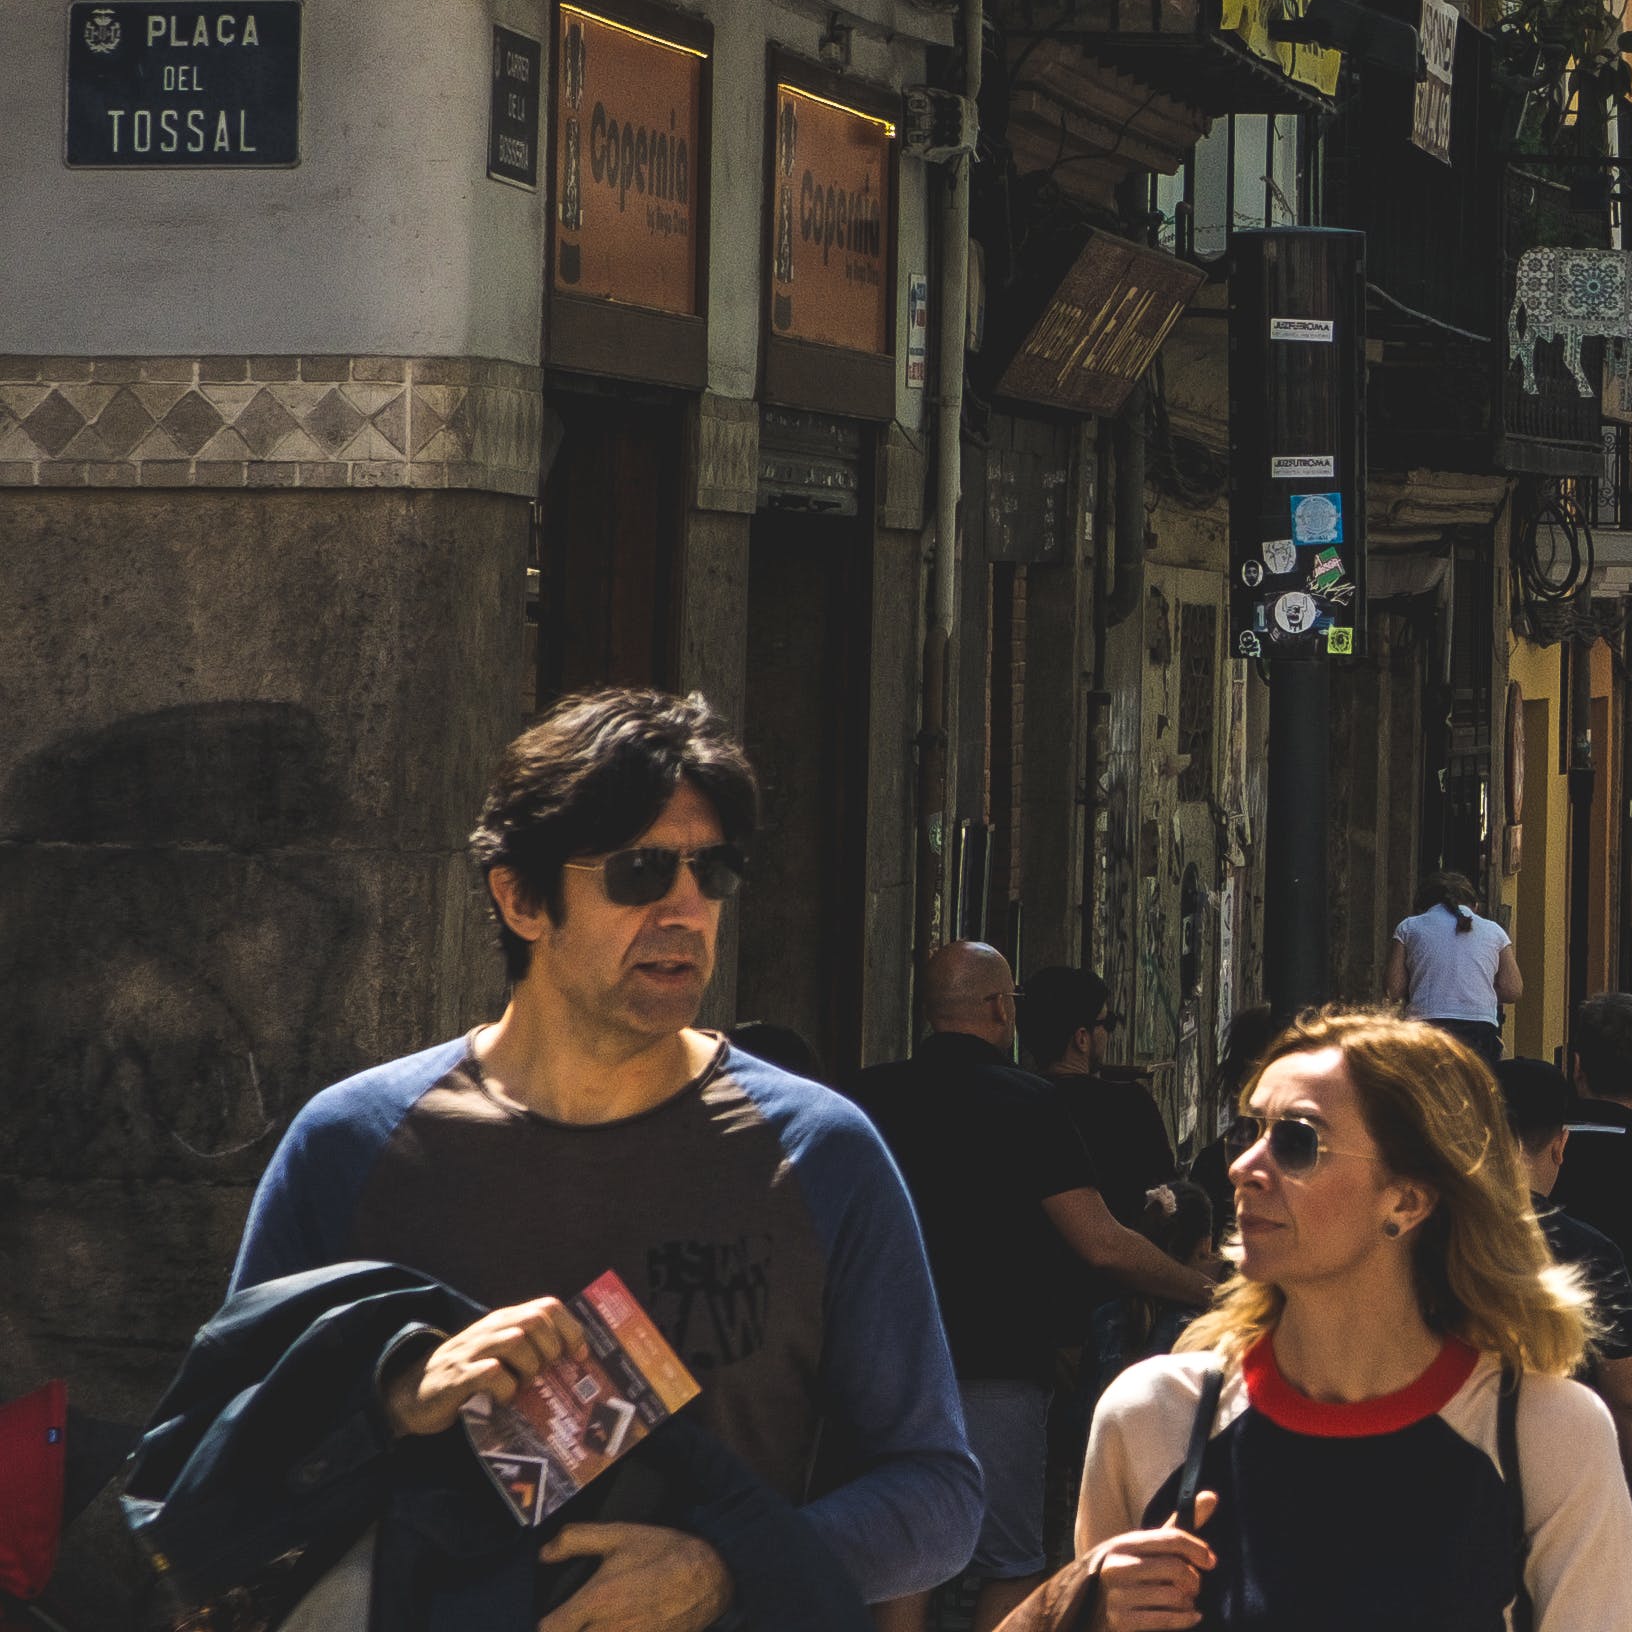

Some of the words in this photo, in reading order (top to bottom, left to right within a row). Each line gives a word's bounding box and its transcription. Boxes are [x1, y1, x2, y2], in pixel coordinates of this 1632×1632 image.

[147, 15, 258, 46] PLAÇA
[163, 66, 203, 91] DEL
[107, 110, 256, 152] TOSSAL
[590, 101, 689, 212] Copernia
